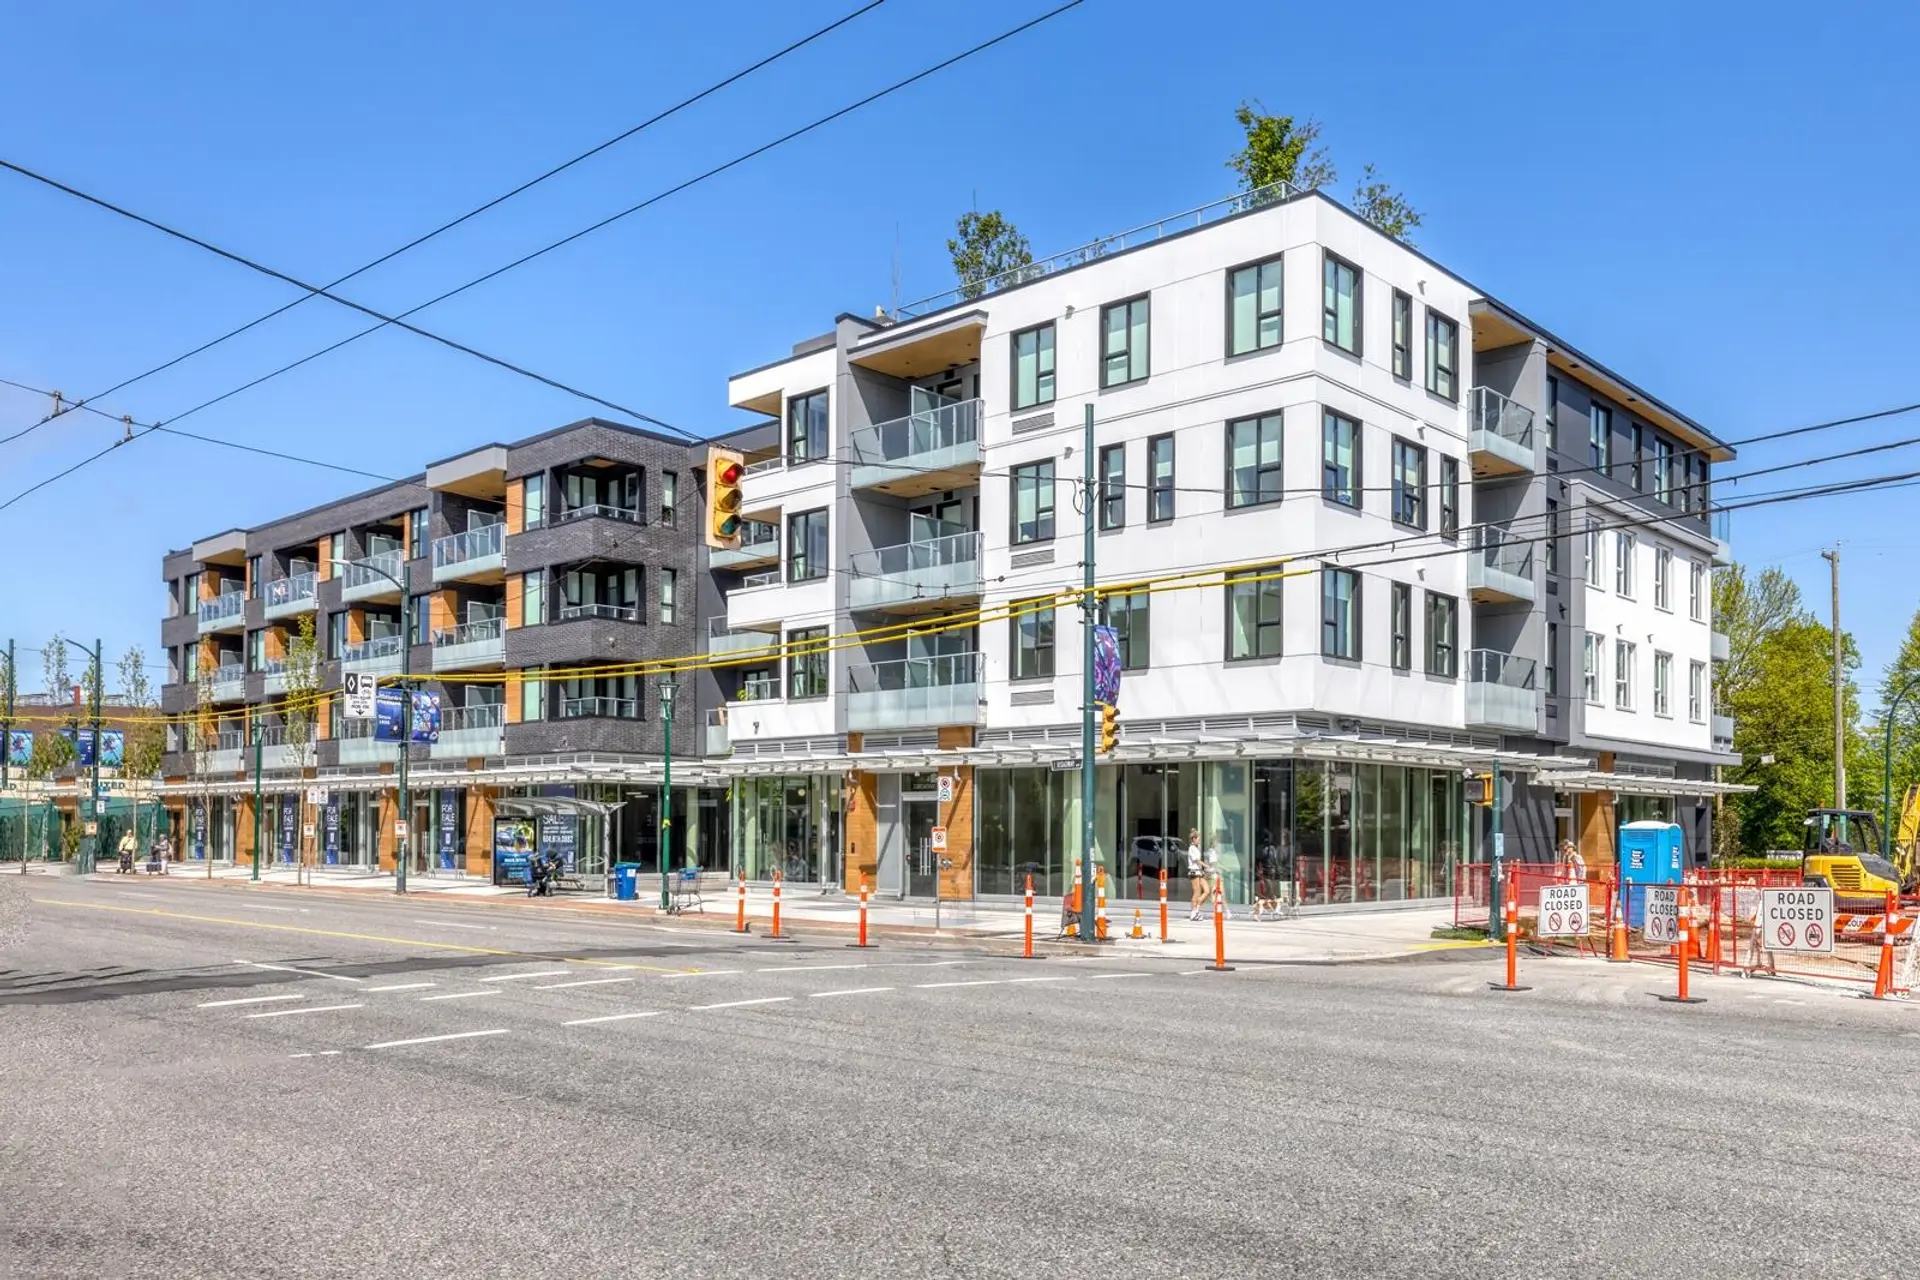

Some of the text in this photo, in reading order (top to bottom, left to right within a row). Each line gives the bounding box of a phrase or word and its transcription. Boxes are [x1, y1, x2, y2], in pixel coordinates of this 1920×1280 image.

[1549, 888, 1577, 899] ROAD
[1654, 890, 1676, 901] ROAD
[1777, 892, 1816, 905] ROAD
[1544, 900, 1583, 911] CLOSED
[1649, 903, 1679, 916] CLOSED
[1770, 907, 1824, 921] CLOSED
